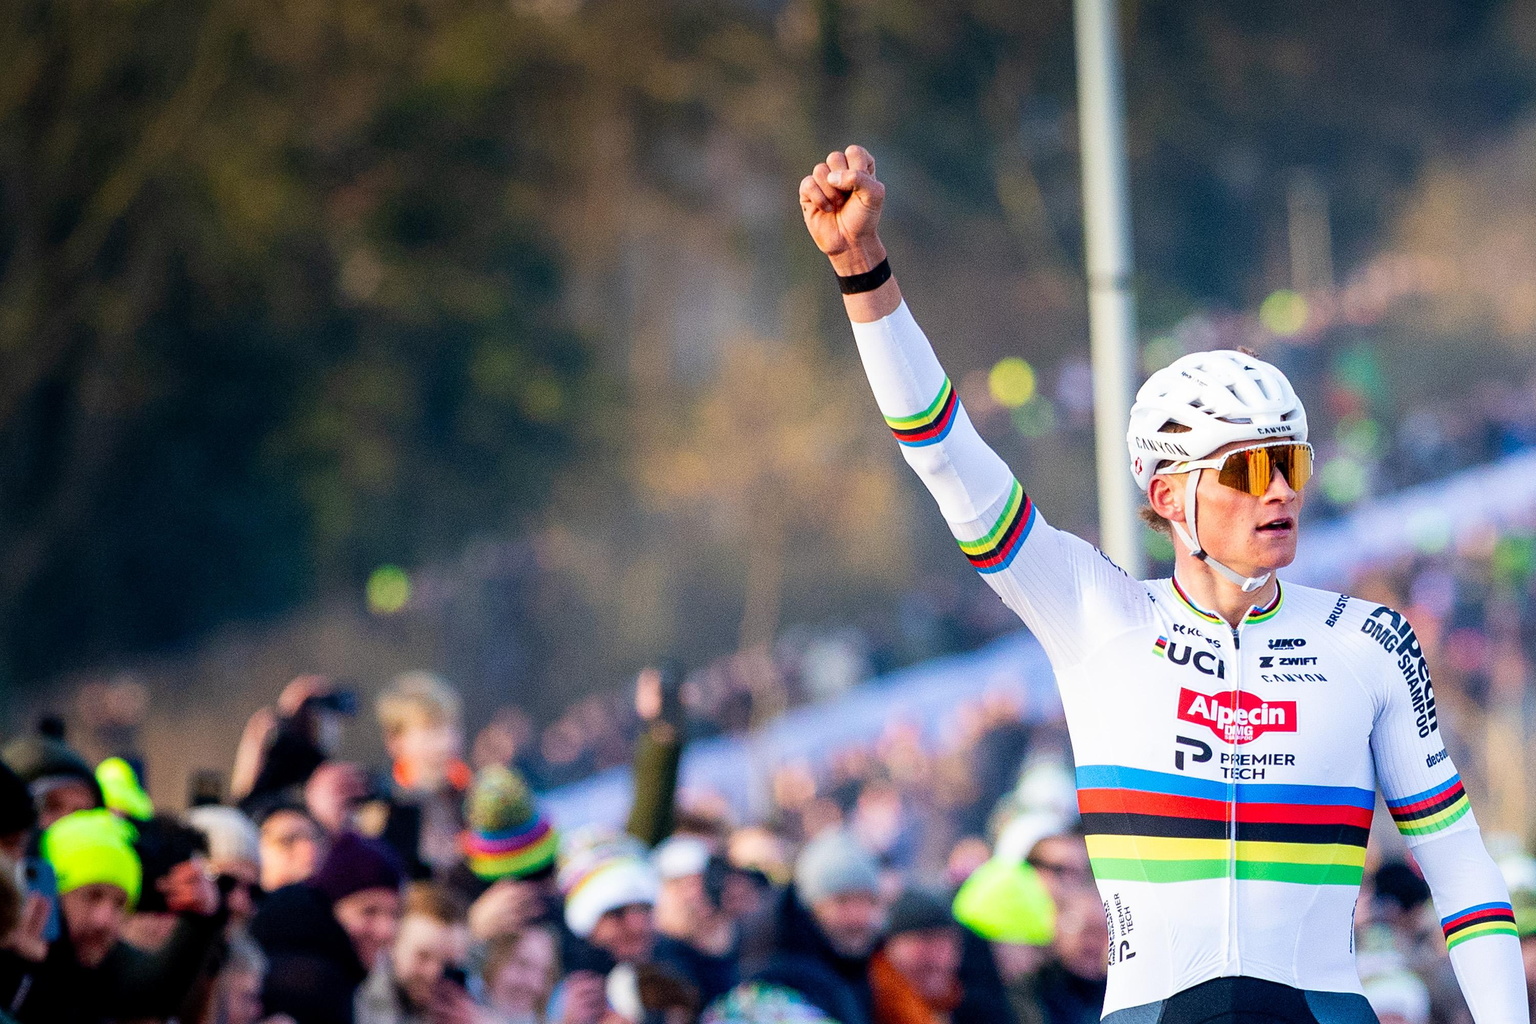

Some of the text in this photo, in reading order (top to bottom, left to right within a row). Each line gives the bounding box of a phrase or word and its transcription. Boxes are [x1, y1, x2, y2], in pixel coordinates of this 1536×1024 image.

[1257, 425, 1292, 435] CANYON
[1135, 436, 1190, 457] CANYON
[1167, 641, 1225, 680] UCI
[1279, 656, 1318, 666] ZWIFT
[1261, 673, 1328, 683] CANYON
[1360, 617, 1430, 739] DMG SHAMPOO
[1187, 694, 1286, 730] Alpecin
[1220, 752, 1296, 766] PREMIER
[1220, 766, 1266, 780] TECH
[1113, 892, 1127, 937] PREMIER
[1123, 905, 1134, 935] TECH
